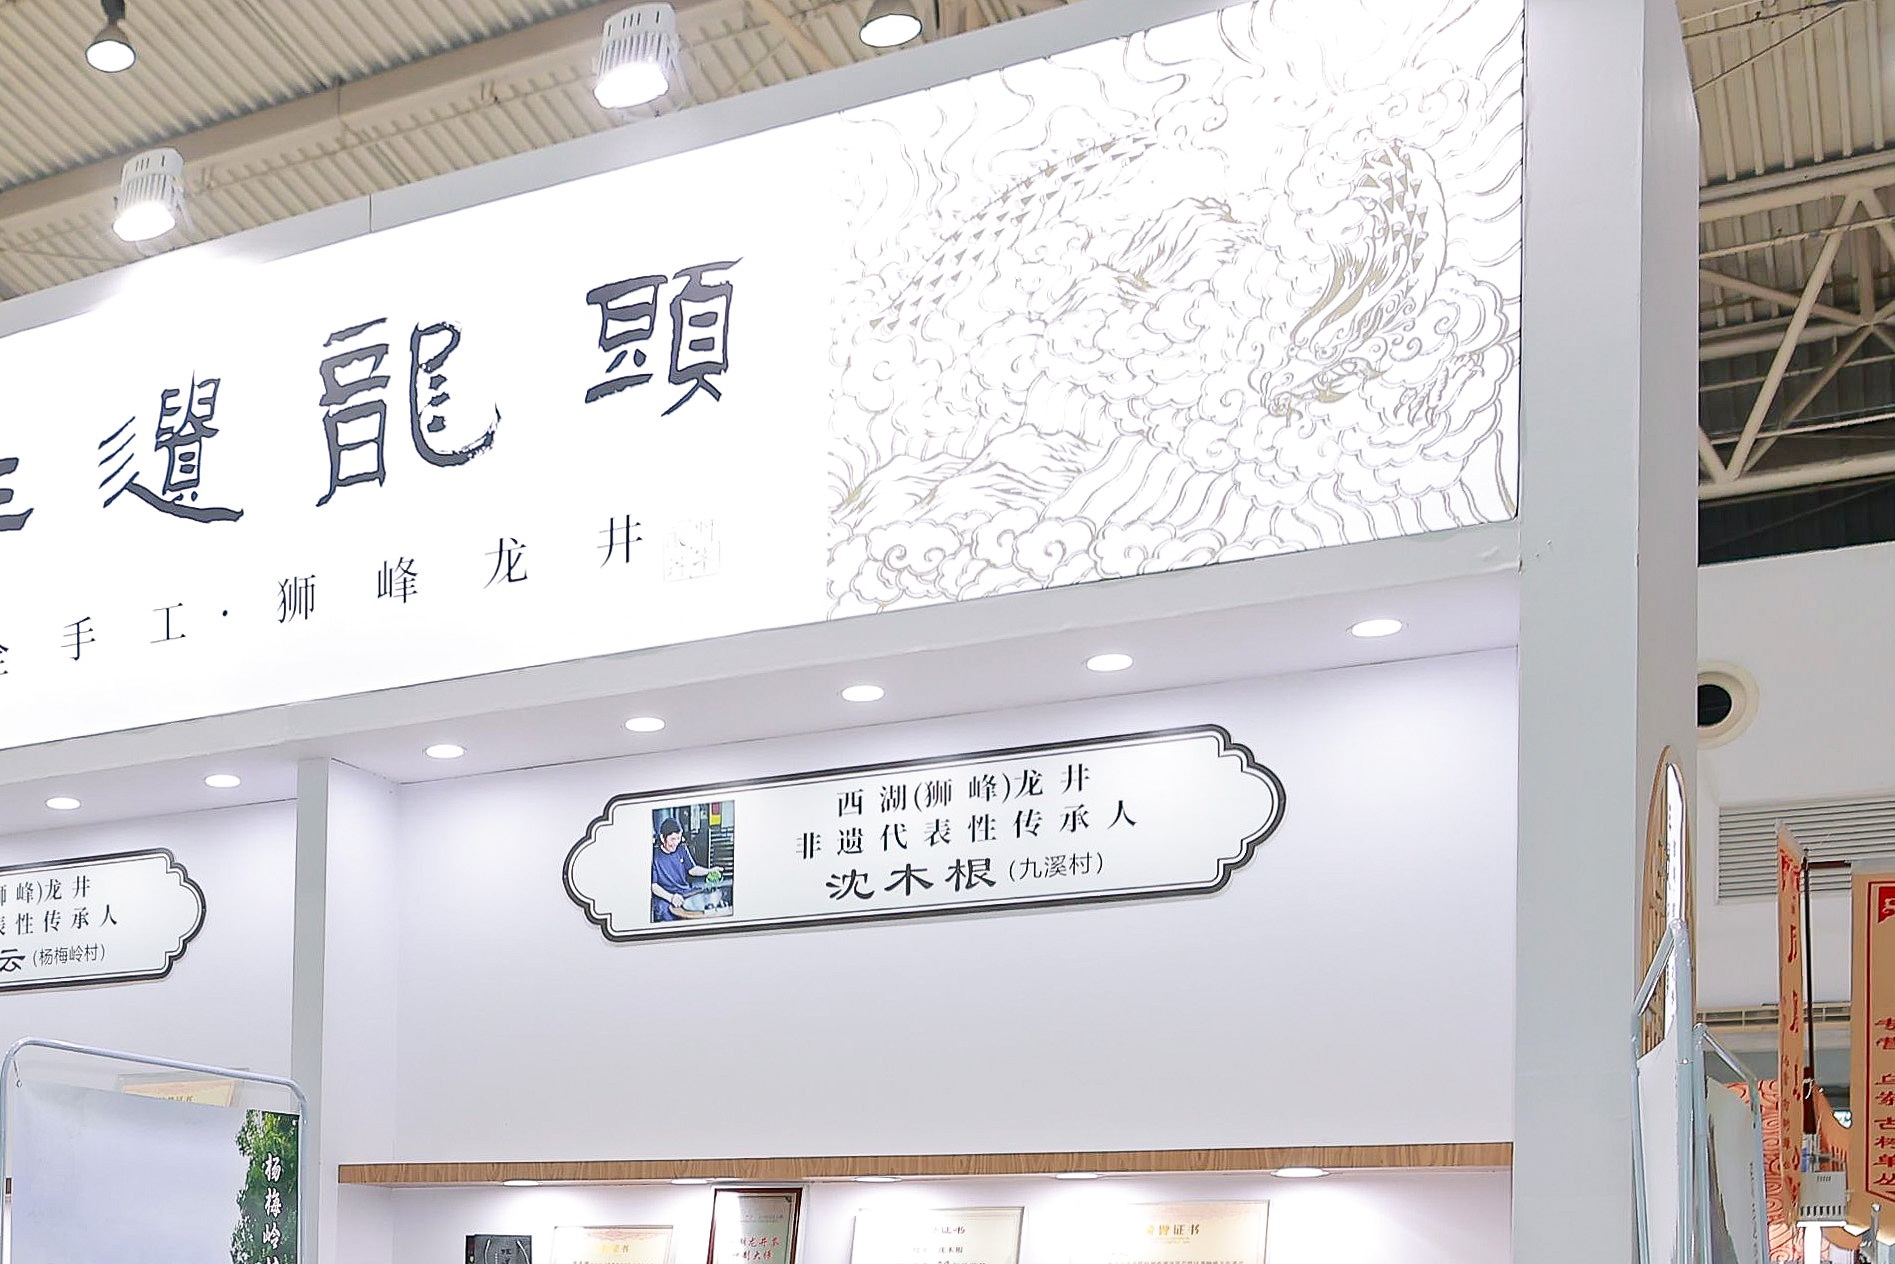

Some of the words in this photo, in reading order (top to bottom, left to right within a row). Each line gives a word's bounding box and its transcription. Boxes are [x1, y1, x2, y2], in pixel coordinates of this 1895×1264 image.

[795, 799, 1138, 860] 非遗代表性传承人
